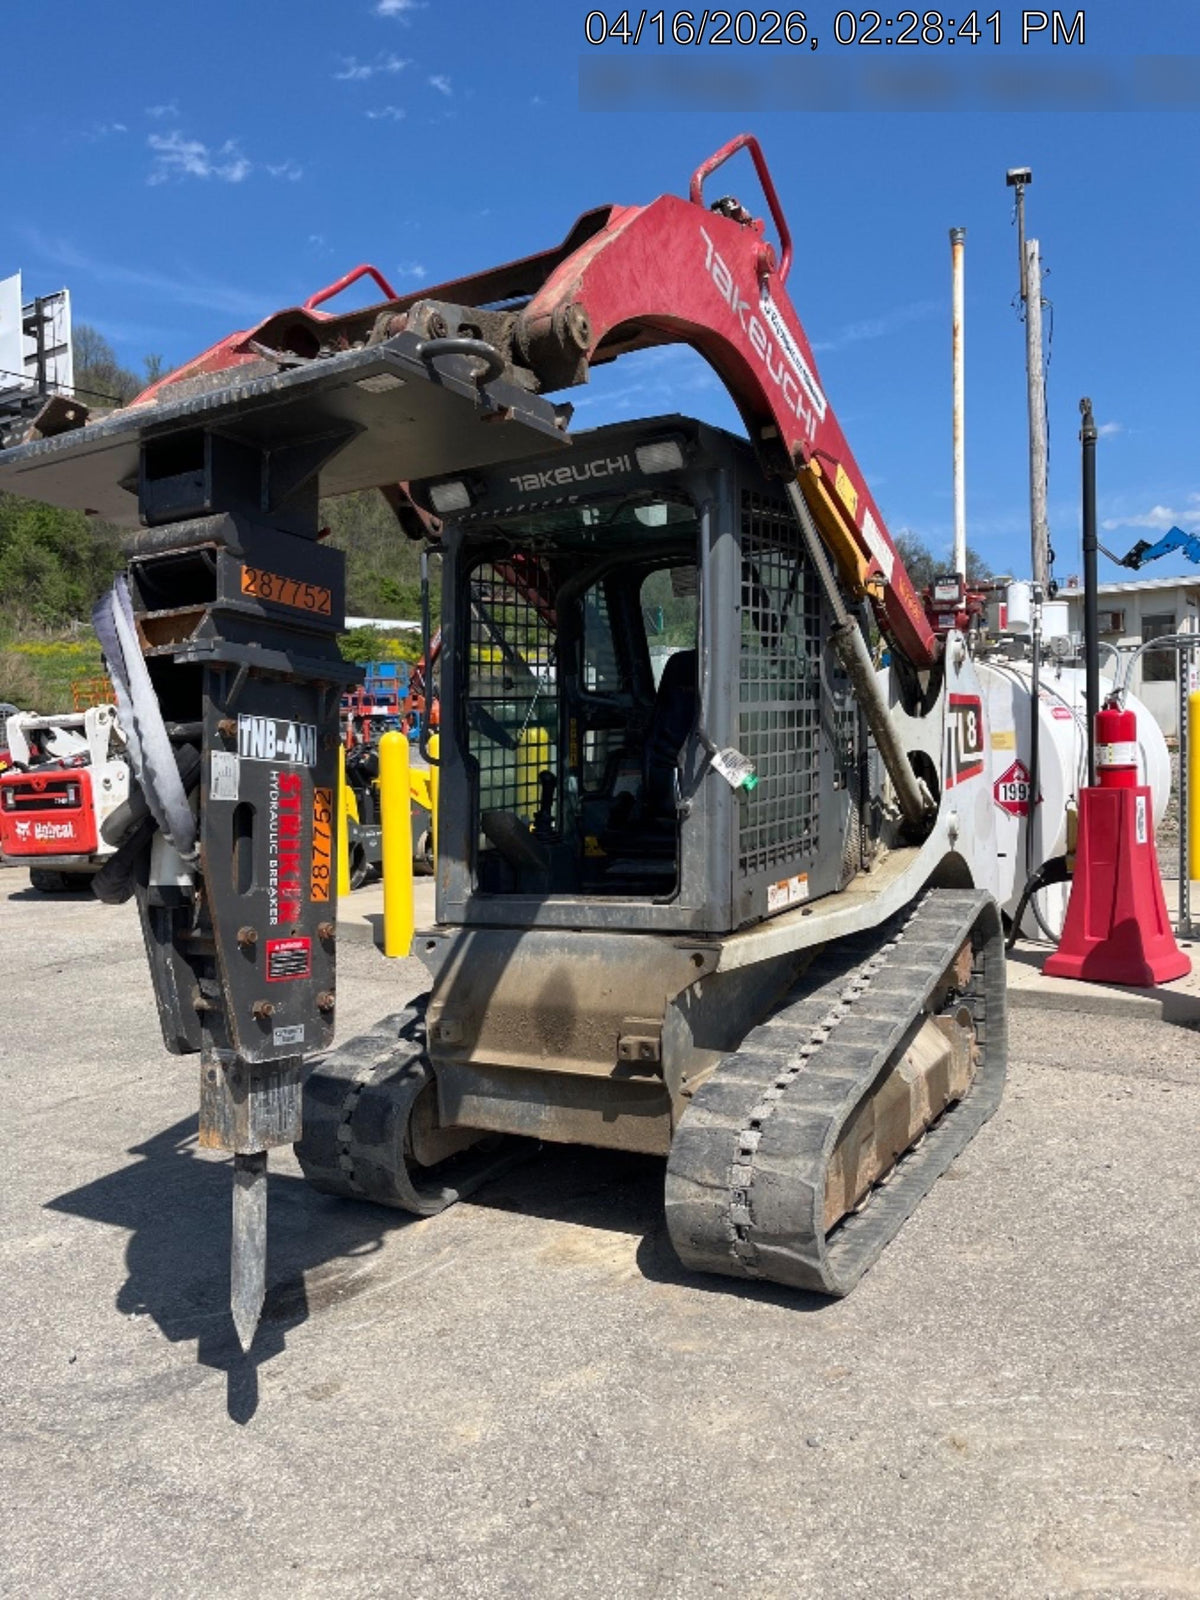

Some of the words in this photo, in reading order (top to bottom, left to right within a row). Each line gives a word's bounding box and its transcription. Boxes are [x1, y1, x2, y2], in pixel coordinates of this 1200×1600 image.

[243, 567, 331, 614] 287752
[239, 714, 316, 766] TNB-4M
[35, 822, 74, 839] Bobcat
[269, 771, 279, 855] HYDRAULIC
[312, 790, 332, 899] 287752
[278, 772, 302, 925] STRIKER
[269, 860, 278, 926] BREAKER
